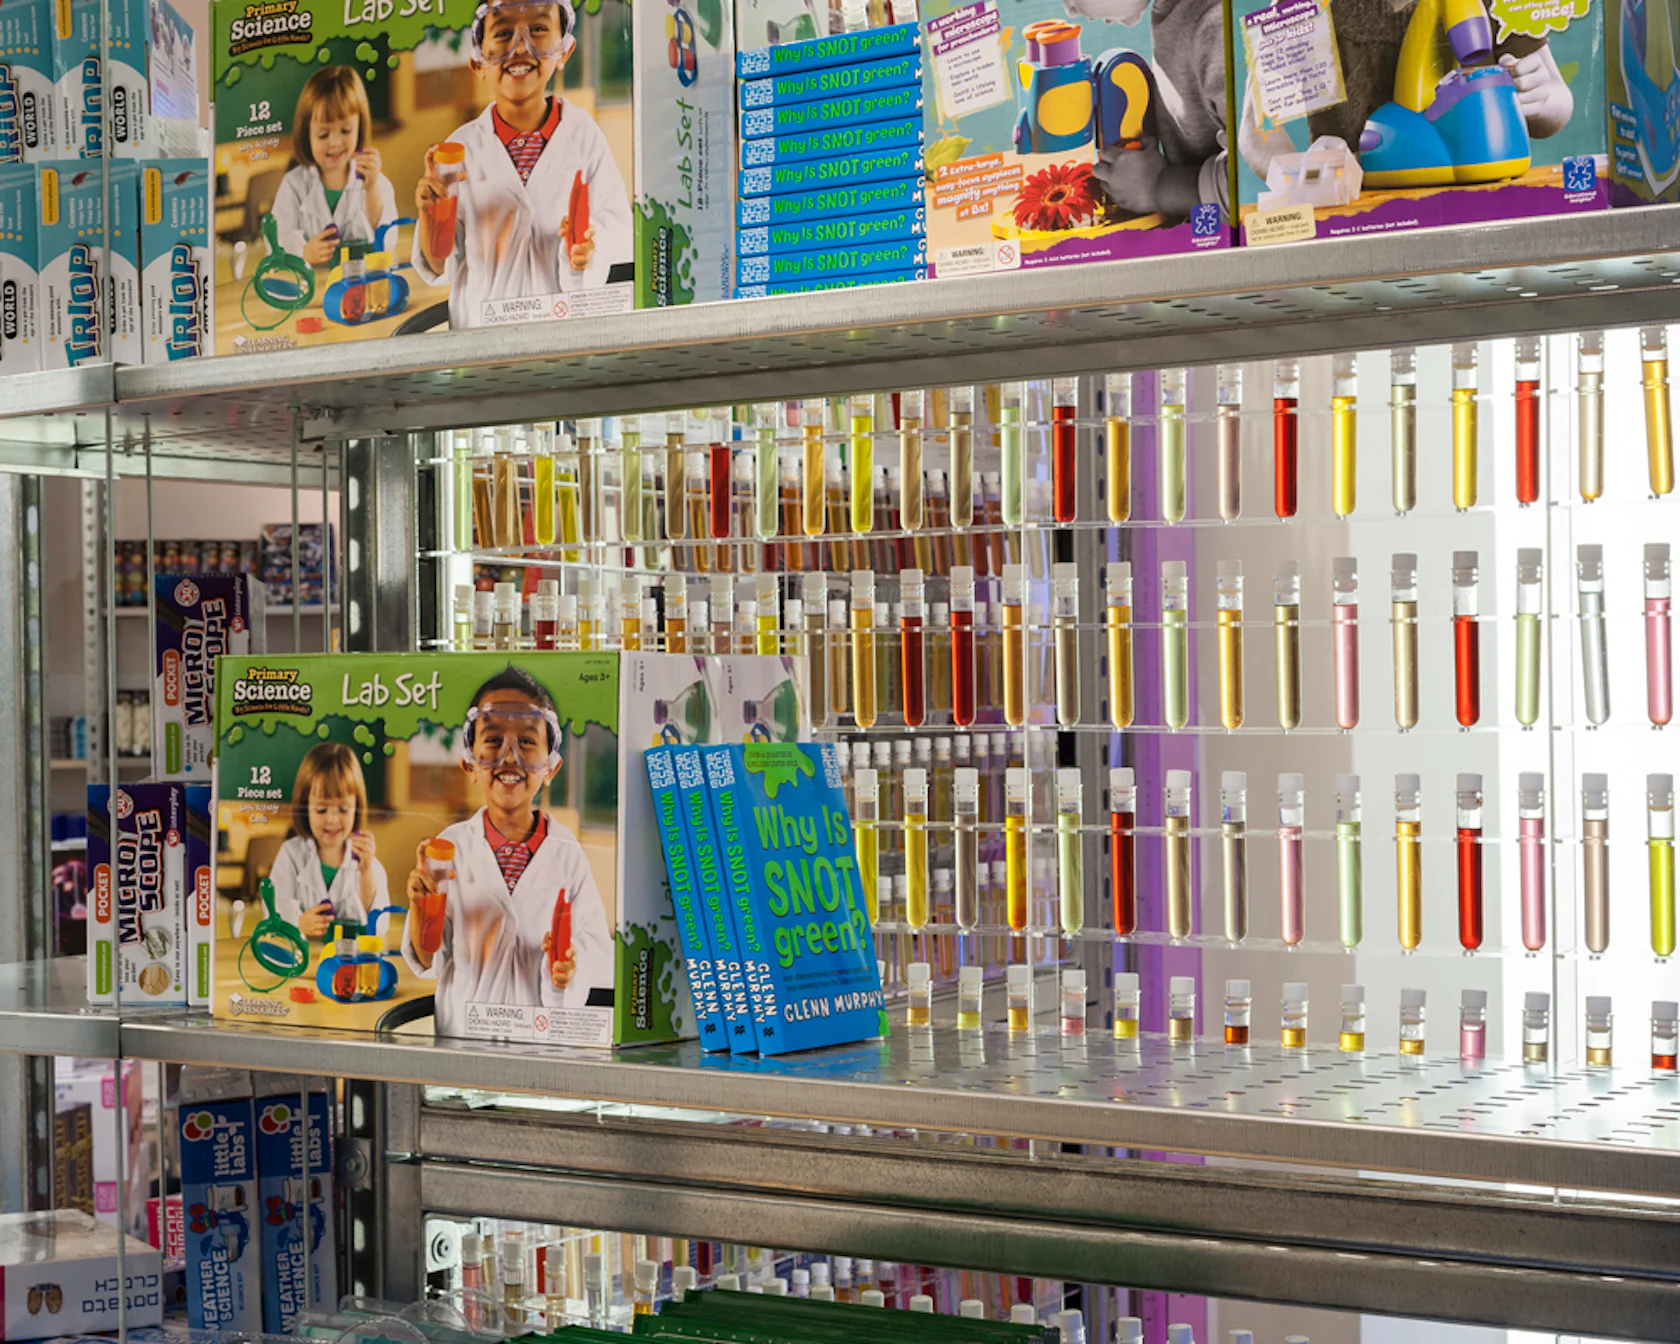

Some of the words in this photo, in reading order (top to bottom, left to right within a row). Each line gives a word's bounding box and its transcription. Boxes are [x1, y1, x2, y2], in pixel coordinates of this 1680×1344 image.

[231, 12, 312, 42] Science
[245, 1, 297, 18] Primary
[343, 0, 394, 26] Lab
[1530, 1, 1575, 21] once!
[773, 47, 801, 63] Why
[803, 44, 815, 57] Is
[817, 35, 859, 59] SNOT
[859, 27, 908, 51] green?
[777, 79, 805, 95] Why
[805, 76, 818, 90] Is
[819, 68, 862, 91] SNOT
[862, 60, 910, 84] green?
[25, 96, 36, 144] WORLD
[115, 90, 126, 138] WORLD
[236, 125, 265, 139] Piece
[265, 120, 283, 134] set
[249, 100, 271, 122] 12
[675, 97, 694, 150] Set
[777, 108, 806, 124] Why
[807, 105, 819, 119] Is
[820, 97, 863, 121] SNOT
[863, 90, 911, 113] green?
[778, 138, 807, 155] Why
[808, 136, 820, 149] Is
[821, 128, 864, 151] SNOT
[865, 121, 913, 145] green?
[676, 156, 693, 209] Lab
[775, 167, 803, 184] Why
[804, 165, 817, 179] Is
[818, 158, 861, 180] SNOT
[861, 151, 909, 174] green?
[938, 165, 949, 178] 2
[773, 198, 802, 215] Why
[803, 195, 815, 209] Is
[816, 189, 859, 211] SNOT
[859, 182, 908, 205] green?
[936, 187, 981, 205] magnify
[772, 228, 801, 245] Why
[801, 226, 814, 241] Is
[815, 220, 857, 242] SNOT
[858, 214, 907, 237] green?
[650, 240, 659, 291] Primary
[657, 227, 667, 306] Science
[773, 258, 802, 275] Why
[803, 256, 815, 270] Is
[817, 250, 859, 271] SNOT
[860, 245, 909, 267] green?
[4, 285, 16, 334] WORLD
[64, 244, 101, 367] TRIOP
[165, 243, 201, 362] TRIOP
[166, 656, 178, 701] POCKET
[182, 628, 208, 727] MICRO
[234, 680, 312, 701] Science
[247, 667, 299, 684] Primary
[341, 672, 390, 707] Lab
[395, 671, 443, 711] Set
[579, 673, 598, 683] Ages
[600, 673, 610, 681] 3+
[237, 787, 265, 799] Piece
[266, 788, 283, 799] set
[250, 765, 272, 785] 12
[660, 790, 675, 827] Why
[688, 790, 704, 827] Why
[719, 790, 735, 827] Why
[753, 804, 818, 855] Why
[822, 804, 848, 846] Is
[667, 826, 680, 843] Is
[695, 826, 709, 843] Is
[726, 826, 739, 843] Is
[137, 811, 163, 912] SCOPE
[667, 843, 692, 893] SNOT
[696, 844, 721, 893] SNOT
[726, 844, 751, 894] SNOT
[98, 871, 109, 917] POCKET
[118, 841, 142, 944] MICRO
[199, 873, 210, 920] POCKET
[764, 856, 856, 917] SNOT
[677, 895, 703, 950] green?
[706, 895, 732, 951] green?
[736, 896, 761, 953] green?
[774, 909, 867, 968] green?
[630, 964, 639, 1016] Primary
[635, 949, 648, 1031] Science
[686, 958, 707, 1019] MURPHY
[699, 960, 719, 1013] GLENN
[715, 959, 737, 1021] MURPHY
[728, 961, 749, 1014] GLENN
[744, 960, 765, 1023] MURPHY
[757, 963, 778, 1016] GLENN
[784, 998, 830, 1022] GLENN
[834, 990, 882, 1013] MURPHY
[213, 1130, 230, 1177] little
[230, 1134, 246, 1176] labs
[290, 1124, 303, 1170] little
[308, 1128, 322, 1168] labs
[82, 1292, 159, 1313] potato
[213, 1249, 233, 1322] SCIENCE
[277, 1252, 293, 1333] WEATHER
